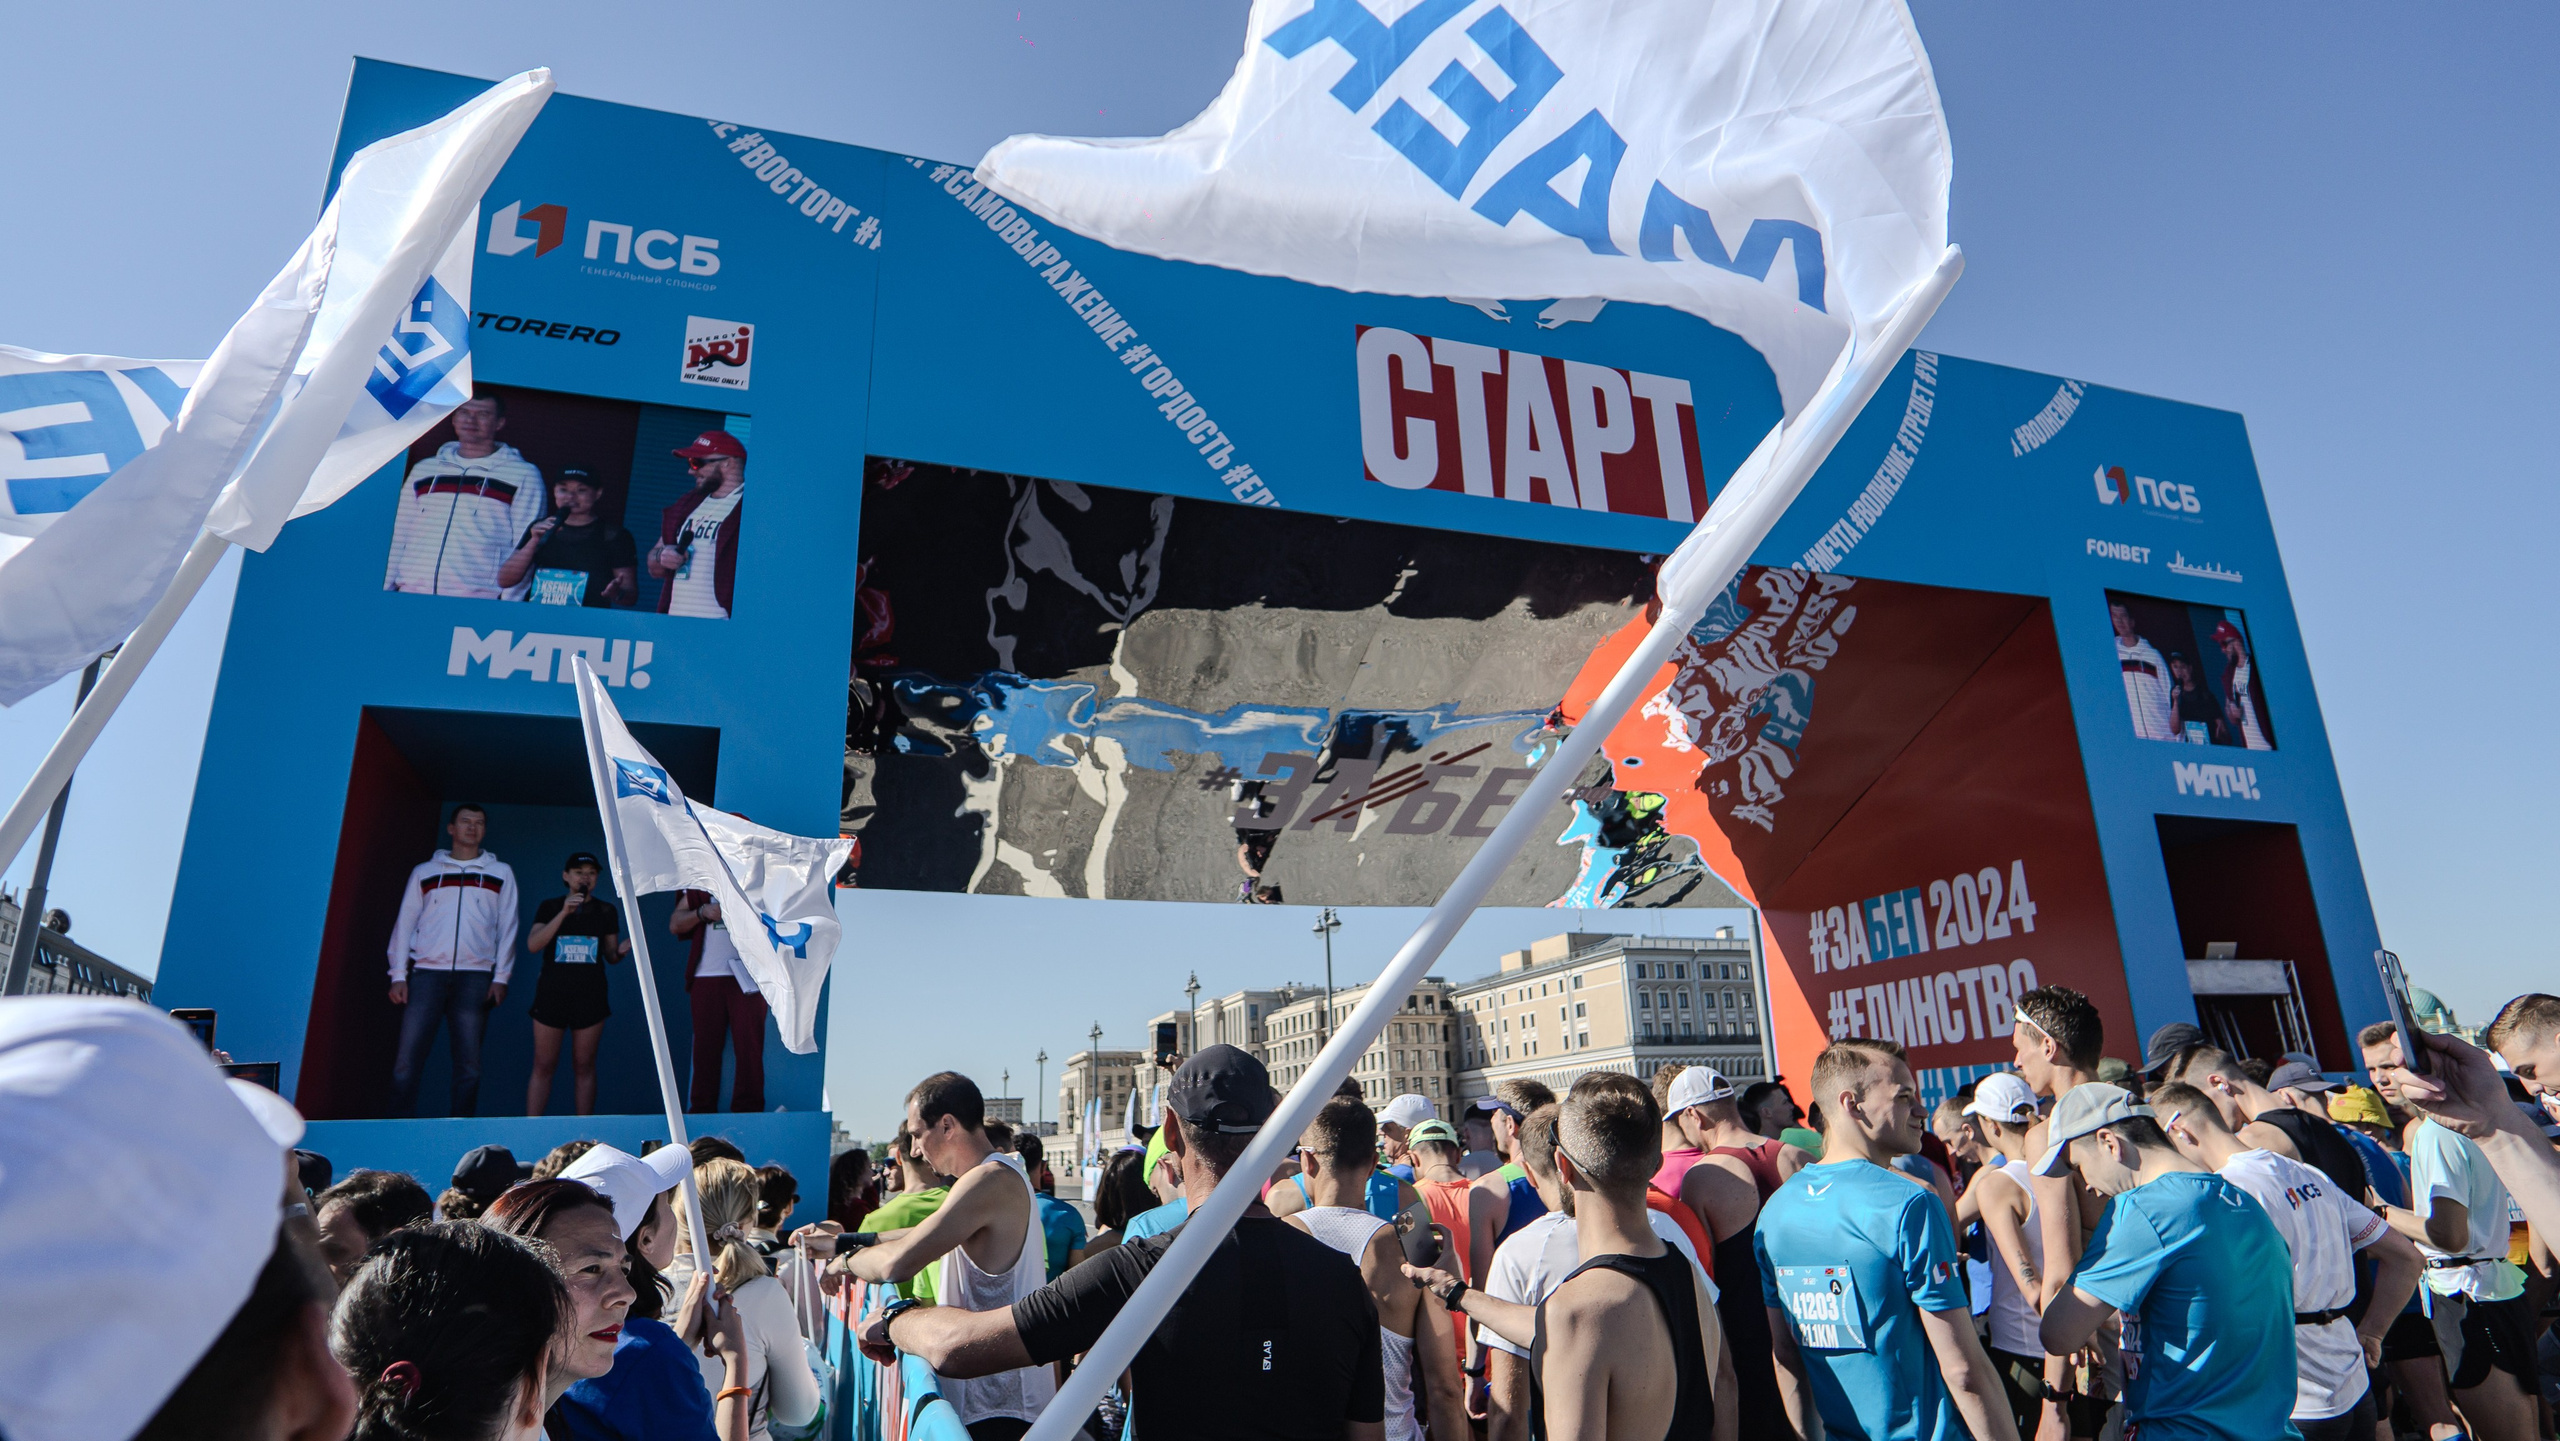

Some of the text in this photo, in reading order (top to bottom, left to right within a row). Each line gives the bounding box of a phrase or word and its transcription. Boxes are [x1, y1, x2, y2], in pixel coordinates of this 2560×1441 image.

[727, 131, 860, 233] #ВОСТОРГ
[580, 264, 718, 292] ГЕНЕРАЛЬНЫЙ СПОНСОР
[583, 219, 721, 277] ПСБ
[928, 163, 1138, 352] #САМОВЫРАЖЕНИЕ
[1119, 343, 1236, 471] #ГОРДОСТЬ
[1356, 327, 1694, 523] СТАРТ
[2013, 383, 2081, 453] #ВОЛНЕНИЕ
[1802, 517, 1863, 574] #МЕЧТА
[1846, 442, 1915, 534] #ВОЛНЕНИЕ
[1896, 378, 1936, 456] #ТРЕПЕТ
[2134, 475, 2201, 514] ПСБ
[2086, 538, 2151, 564] FONBET
[446, 626, 654, 690] МАТЧ!
[2172, 761, 2261, 800] МАТЧ!
[1808, 858, 2038, 975] #ЗАБЕГ 2024
[1792, 1292, 1840, 1321] 41203
[1831, 1281, 1841, 1294] A
